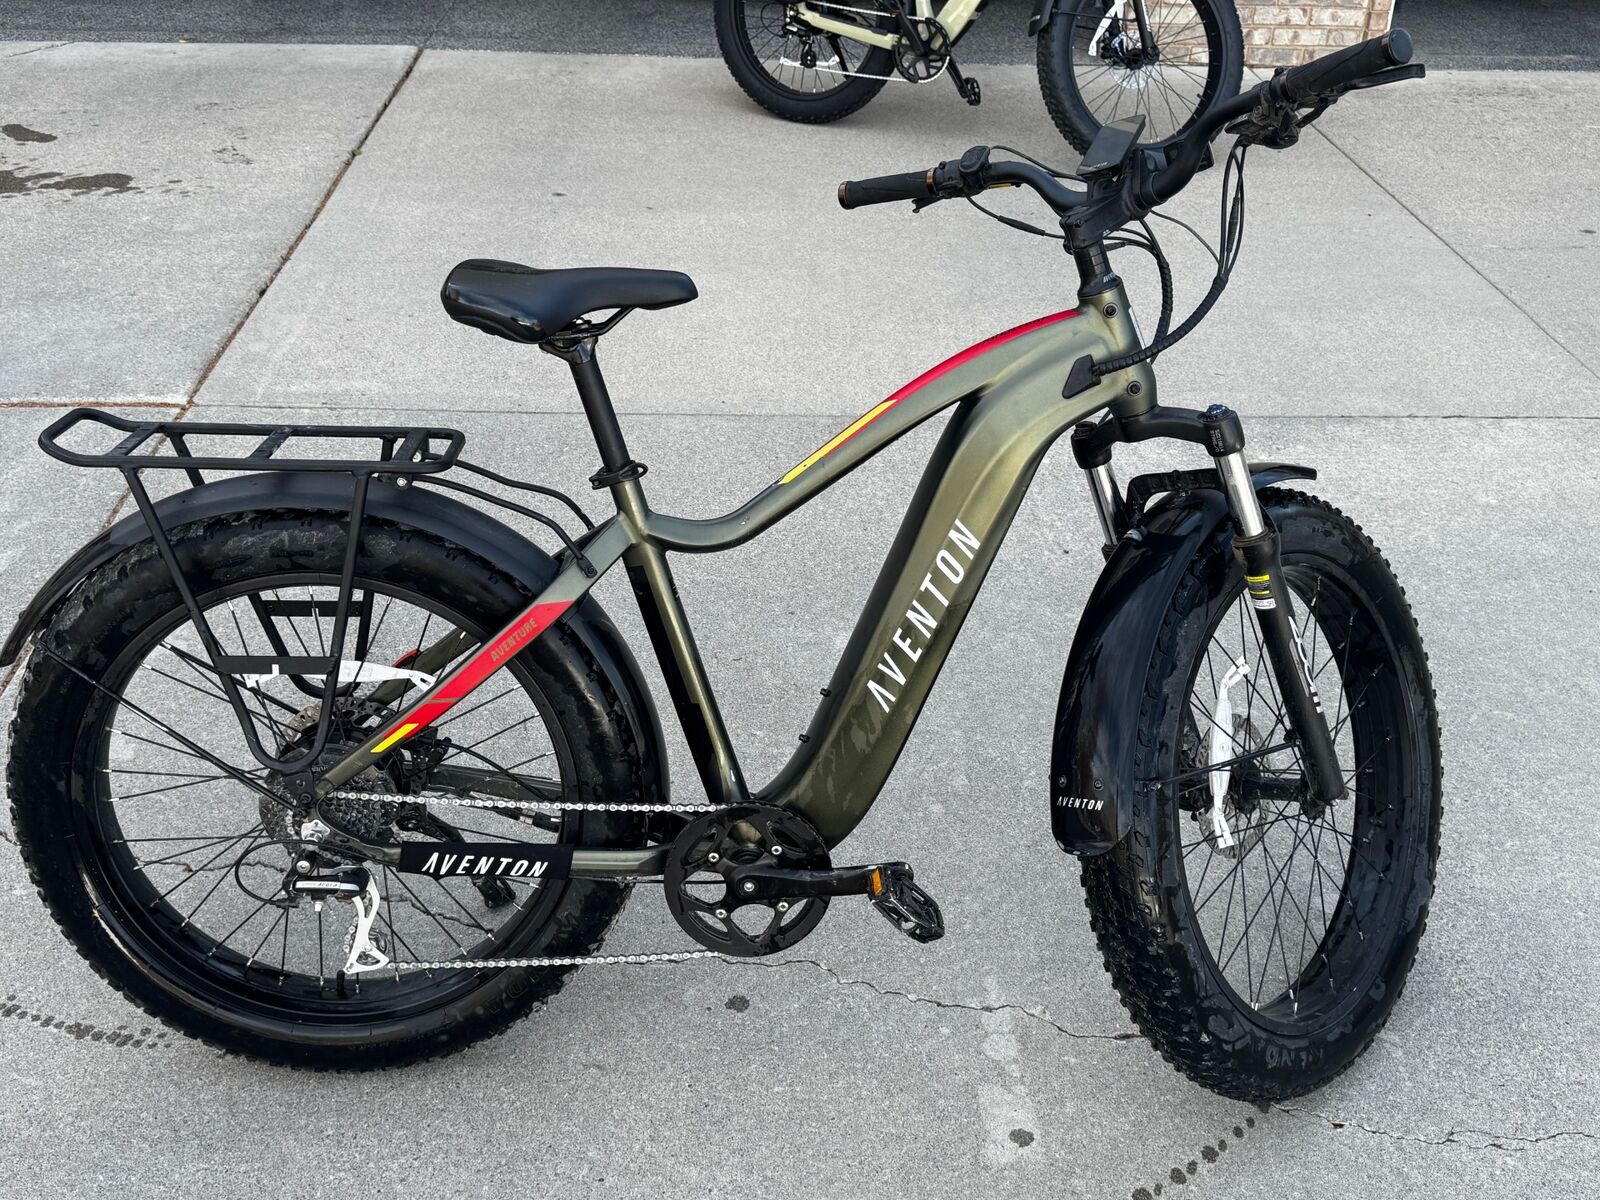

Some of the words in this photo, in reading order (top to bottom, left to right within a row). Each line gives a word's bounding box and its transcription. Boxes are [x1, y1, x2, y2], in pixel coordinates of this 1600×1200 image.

[867, 518, 981, 713] AVENTON
[490, 617, 538, 662] AVENTURE
[1056, 796, 1104, 811] AVENTON
[421, 852, 549, 877] AVENTON
